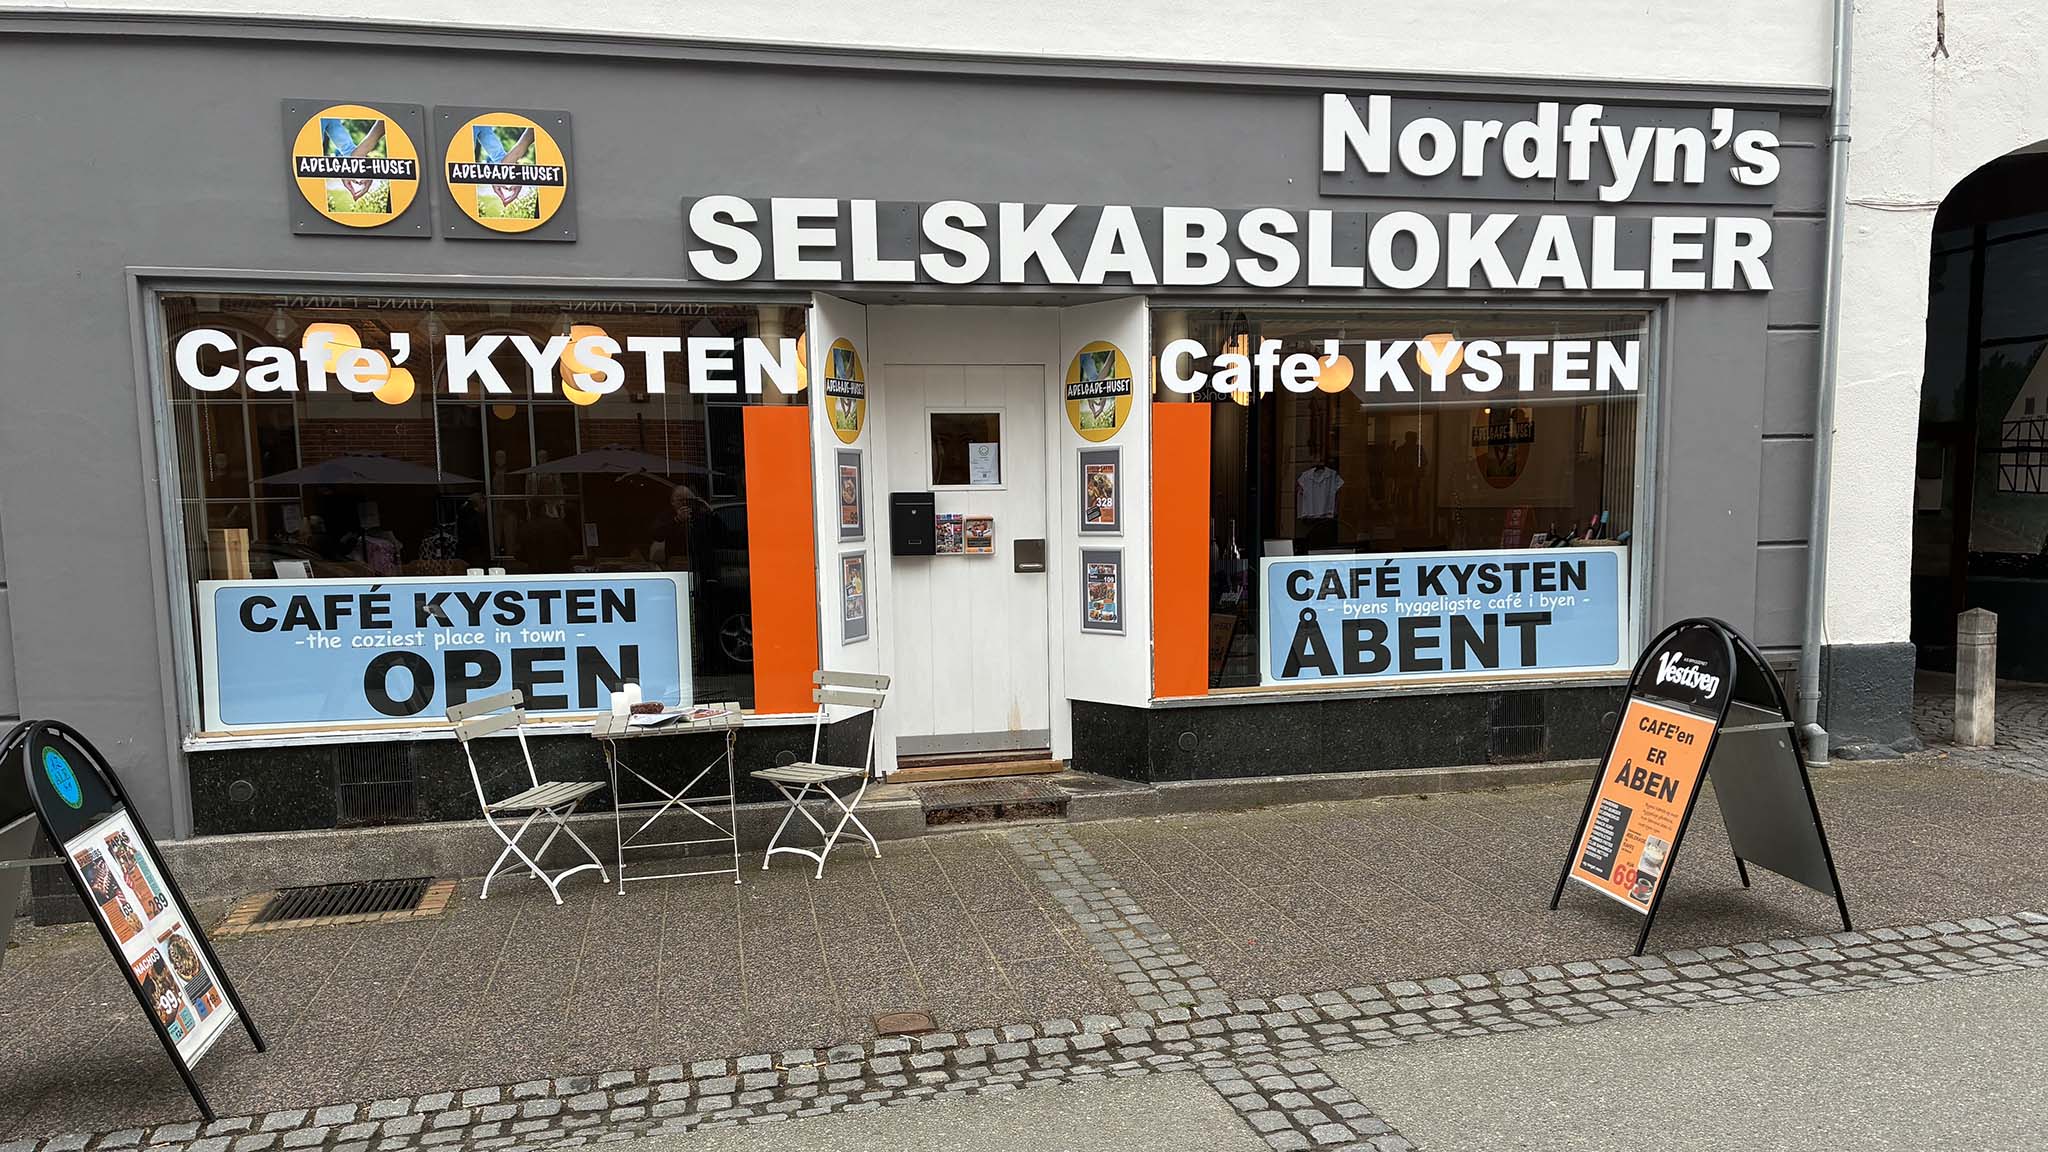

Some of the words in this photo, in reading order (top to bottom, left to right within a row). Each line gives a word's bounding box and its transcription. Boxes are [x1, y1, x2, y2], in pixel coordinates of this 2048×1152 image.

[1322, 93, 1781, 203] Nordfyn's
[299, 157, 413, 176] ADELGADE-HUSET
[452, 164, 562, 184] ADELGADE-HUSET
[688, 195, 1774, 290] SELSKABSLOKALER
[175, 328, 410, 393] Cafe'
[445, 333, 799, 395] KYSTEN
[1160, 338, 1340, 395] Cafe'
[1365, 339, 1640, 392] KYSTEN
[826, 377, 865, 397] ADELGADE-HUSET
[1067, 377, 1130, 397] ADELGADE-HUSET
[1096, 497, 1113, 507] 328
[1286, 559, 1401, 602] CAFÉ
[1417, 560, 1587, 598] KYSTEN
[238, 584, 392, 633] CAFÉ
[414, 588, 637, 629] KYSTEN
[1343, 599, 1388, 619] byens
[1395, 595, 1481, 618] hyggeligste
[1488, 592, 1522, 609] café
[1529, 593, 1534, 608] i
[1540, 592, 1576, 613] byen
[351, 628, 426, 648] coziest
[434, 628, 485, 651] place
[494, 627, 512, 644] in
[519, 628, 567, 644] town
[1281, 607, 1552, 680] ÅBENT
[364, 644, 641, 717] OPEN
[1656, 651, 1720, 699] Vestfyen
[1639, 716, 1695, 746] CAFE'en
[1646, 747, 1667, 766] ER
[1614, 758, 1680, 804] ÅBEN
[105, 831, 130, 850] TAPAS
[148, 892, 169, 914] 289
[133, 948, 160, 975] NACHOS
